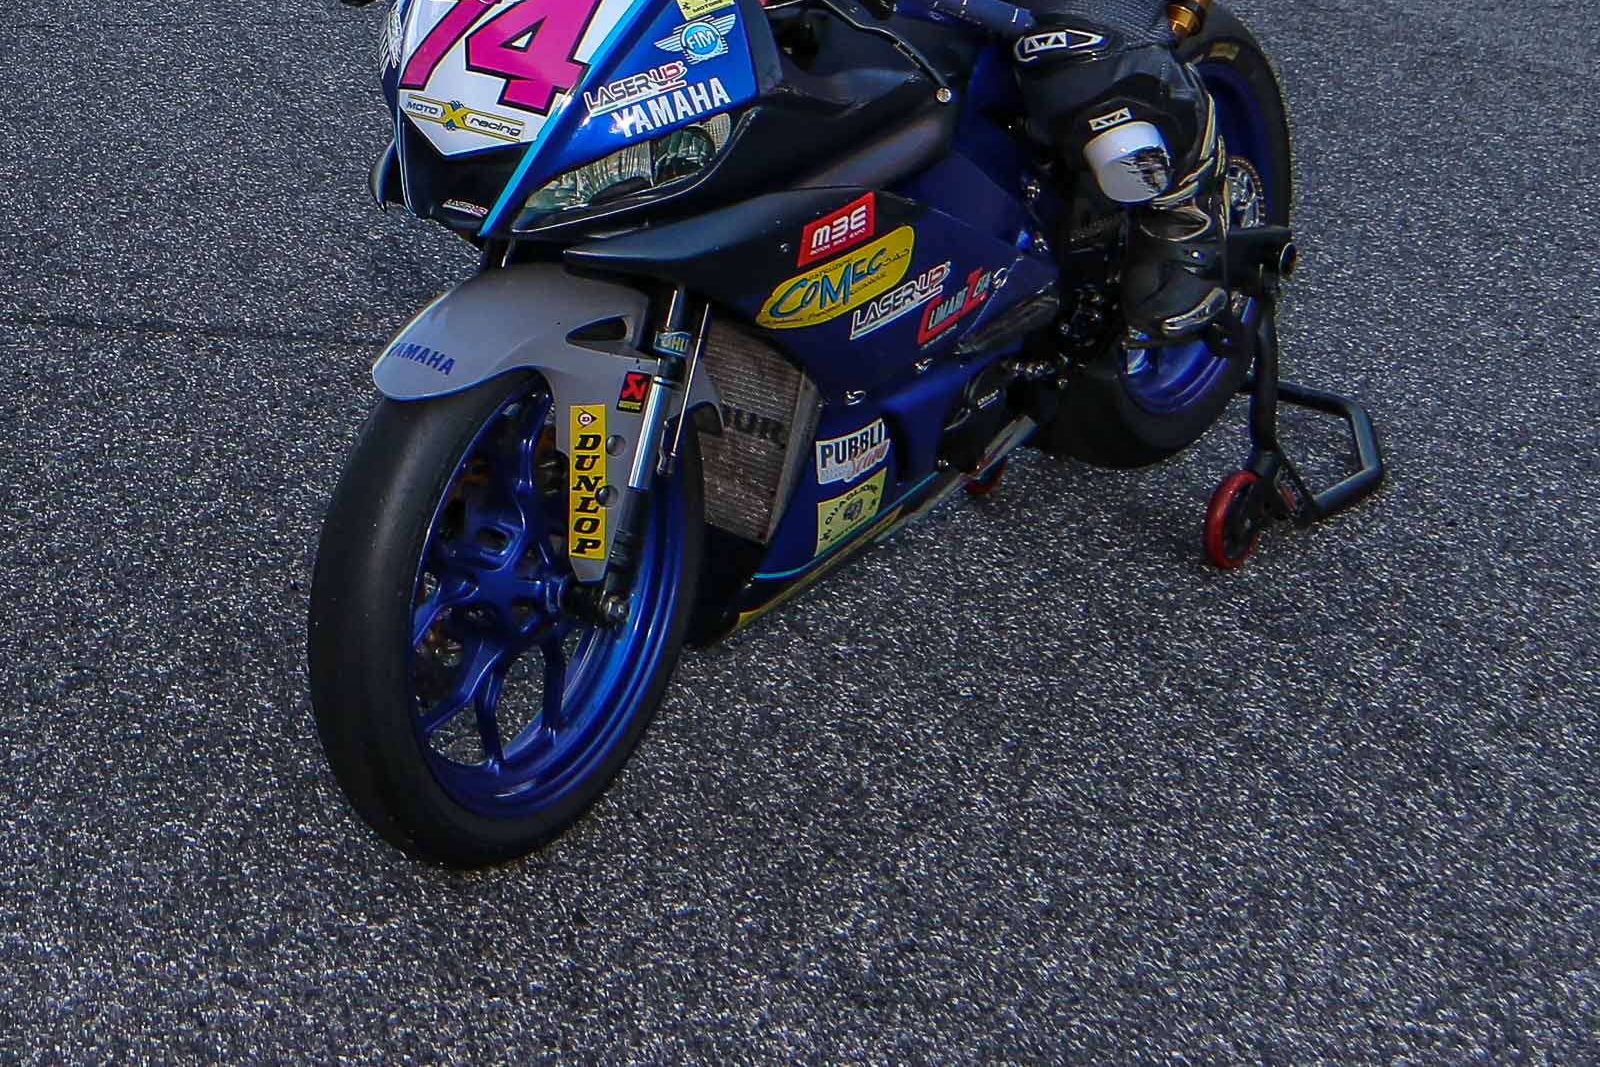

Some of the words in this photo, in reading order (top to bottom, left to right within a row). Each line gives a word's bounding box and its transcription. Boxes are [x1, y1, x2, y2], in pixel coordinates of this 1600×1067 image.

[686, 29, 717, 50] FIM
[406, 101, 439, 115] MOTO
[470, 116, 522, 137] racing
[610, 77, 731, 138] YAMAHA
[571, 434, 603, 555] DUNLOP
